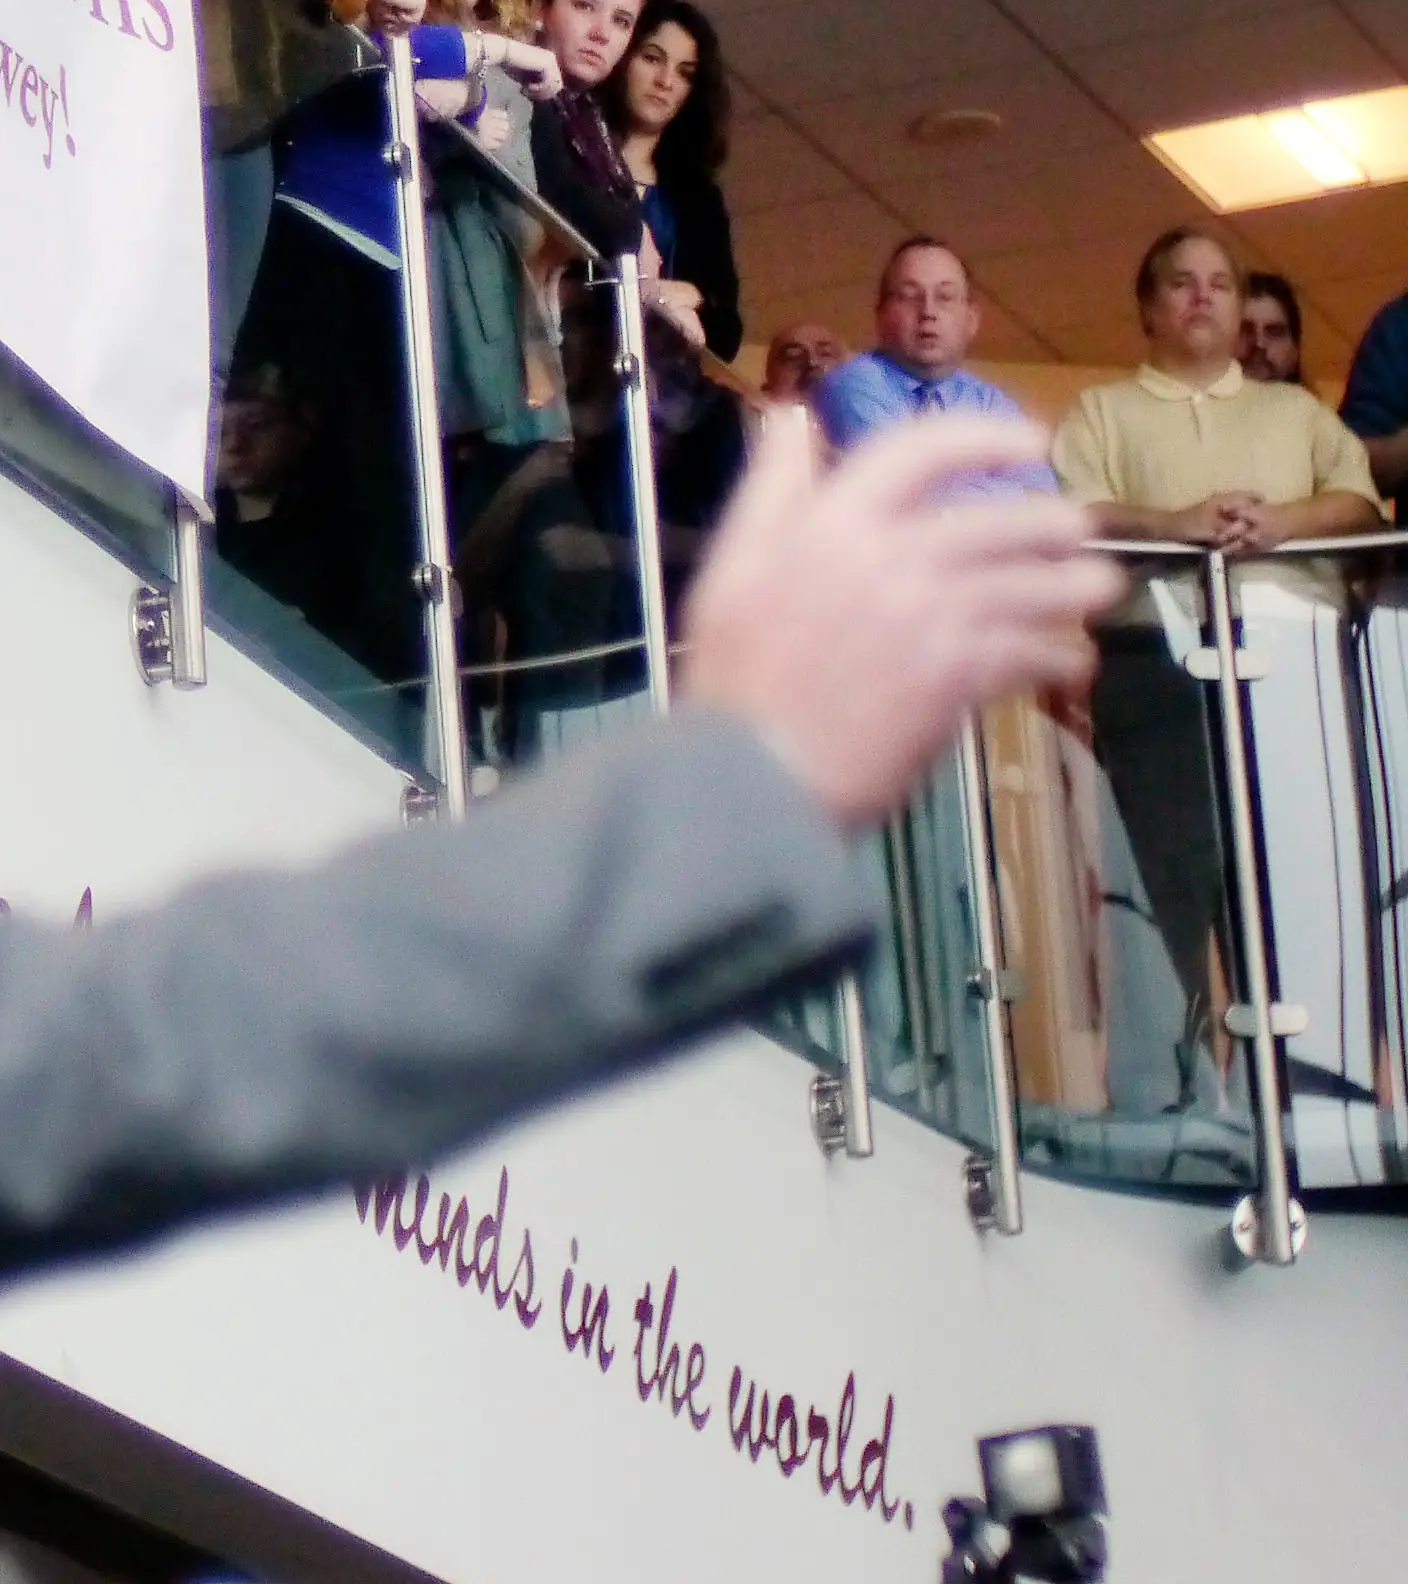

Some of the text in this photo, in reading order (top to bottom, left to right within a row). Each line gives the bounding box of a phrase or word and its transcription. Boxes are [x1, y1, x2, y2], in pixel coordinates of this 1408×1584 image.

[559, 1237, 616, 1373] in
[633, 1266, 711, 1432] the
[728, 1366, 915, 1530] world.
